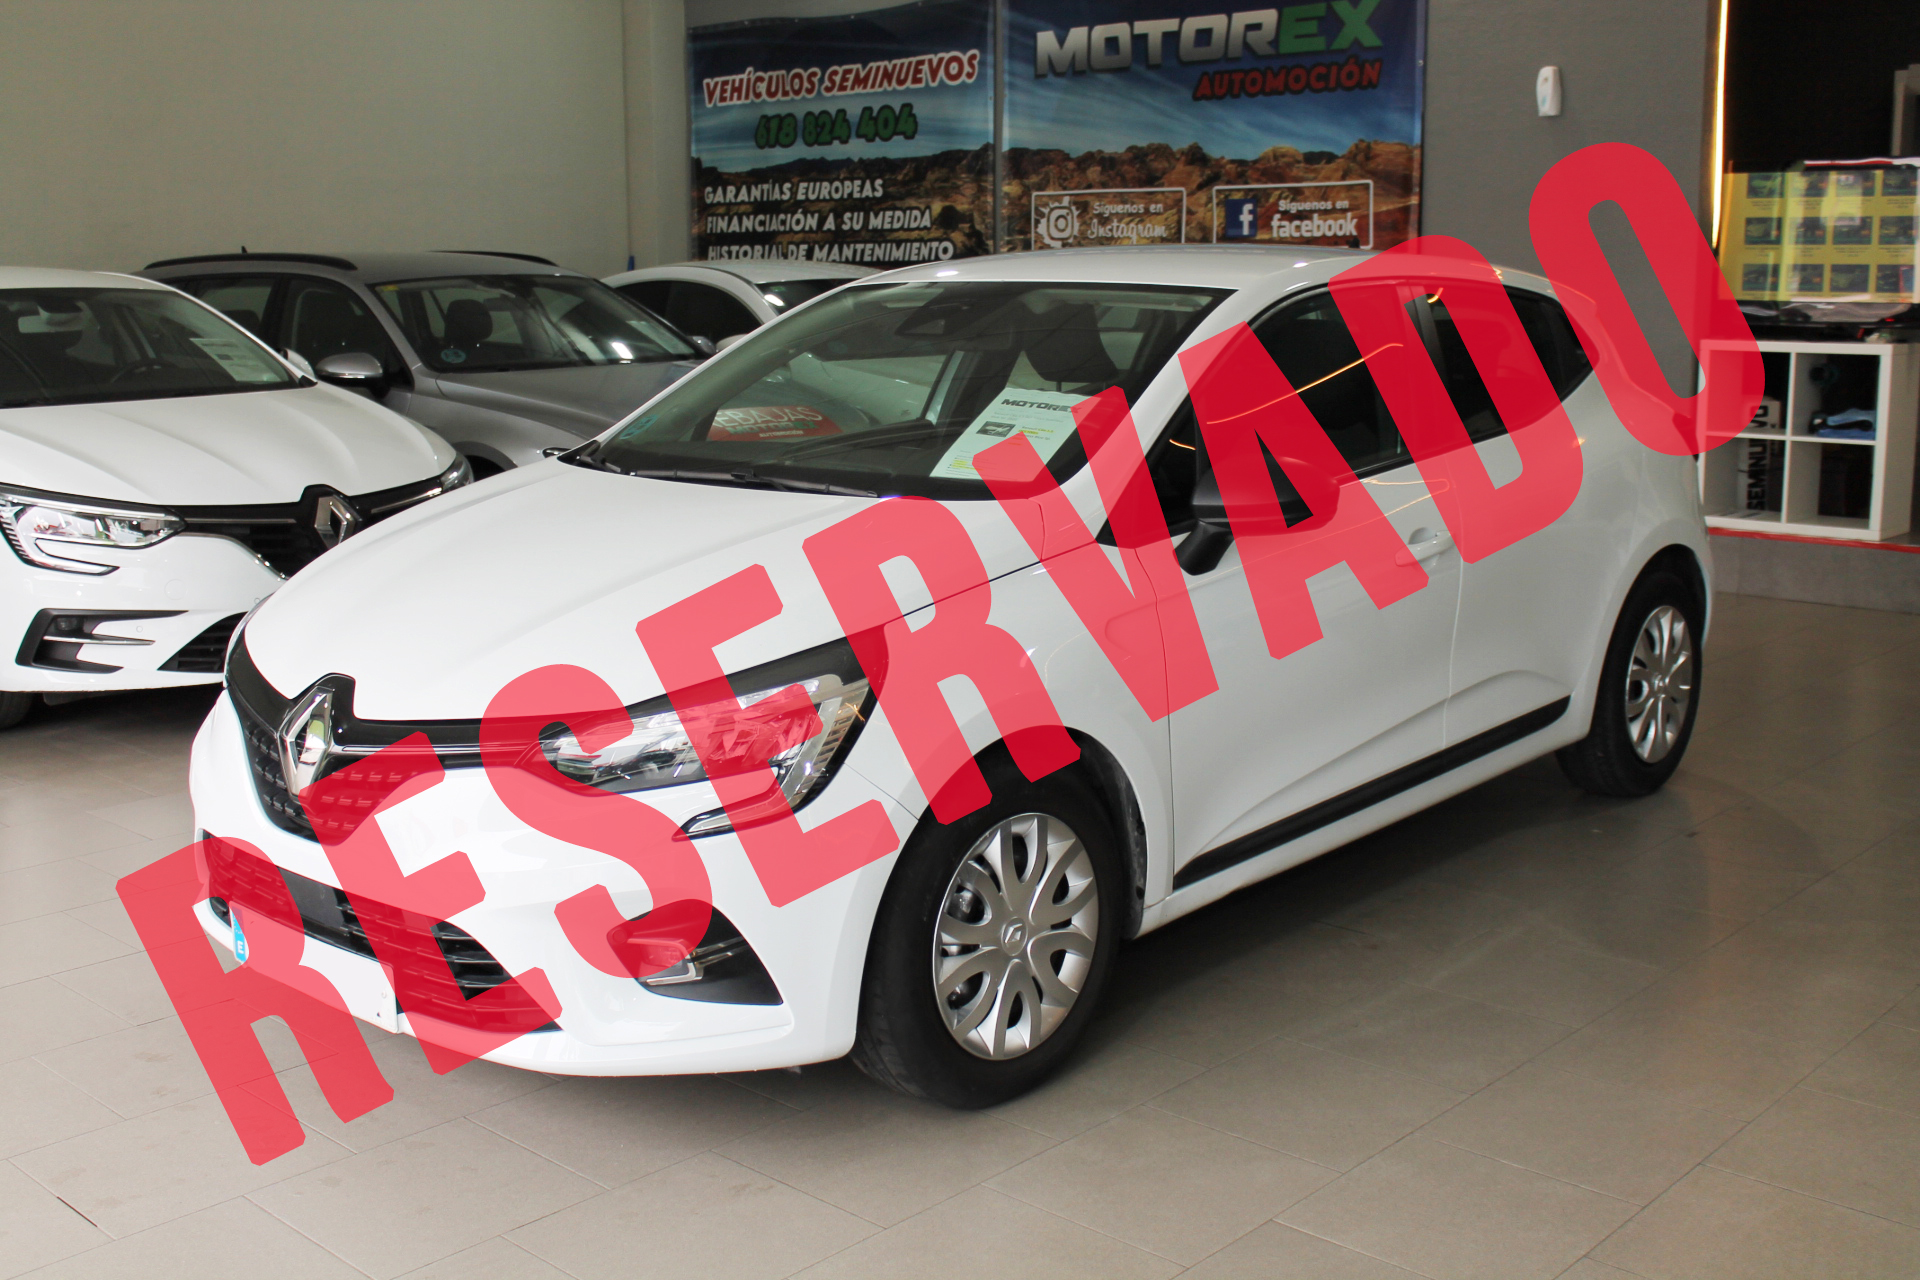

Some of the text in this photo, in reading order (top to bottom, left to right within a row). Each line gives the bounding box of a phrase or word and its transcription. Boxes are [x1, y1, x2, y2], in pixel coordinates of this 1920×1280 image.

[1035, 0, 1383, 78] MOTOREX
[703, 49, 979, 107] VEHÍCULOS SEMINUEVOS
[1194, 56, 1382, 100] AUTOMOCIÓN
[755, 103, 918, 149] 618 824 404
[704, 178, 883, 204] GARANTÍAS EUROPEAS
[1149, 203, 1163, 213] en
[1335, 200, 1349, 209] en
[706, 209, 932, 233] FINANCIACIÓN A SU MEDIDA
[1087, 219, 1167, 244] Instagram
[1271, 213, 1358, 238] facebook
[708, 241, 954, 262] HISTORIAL DE MANTENIMIENTO
[713, 408, 823, 427] EBAJAS
